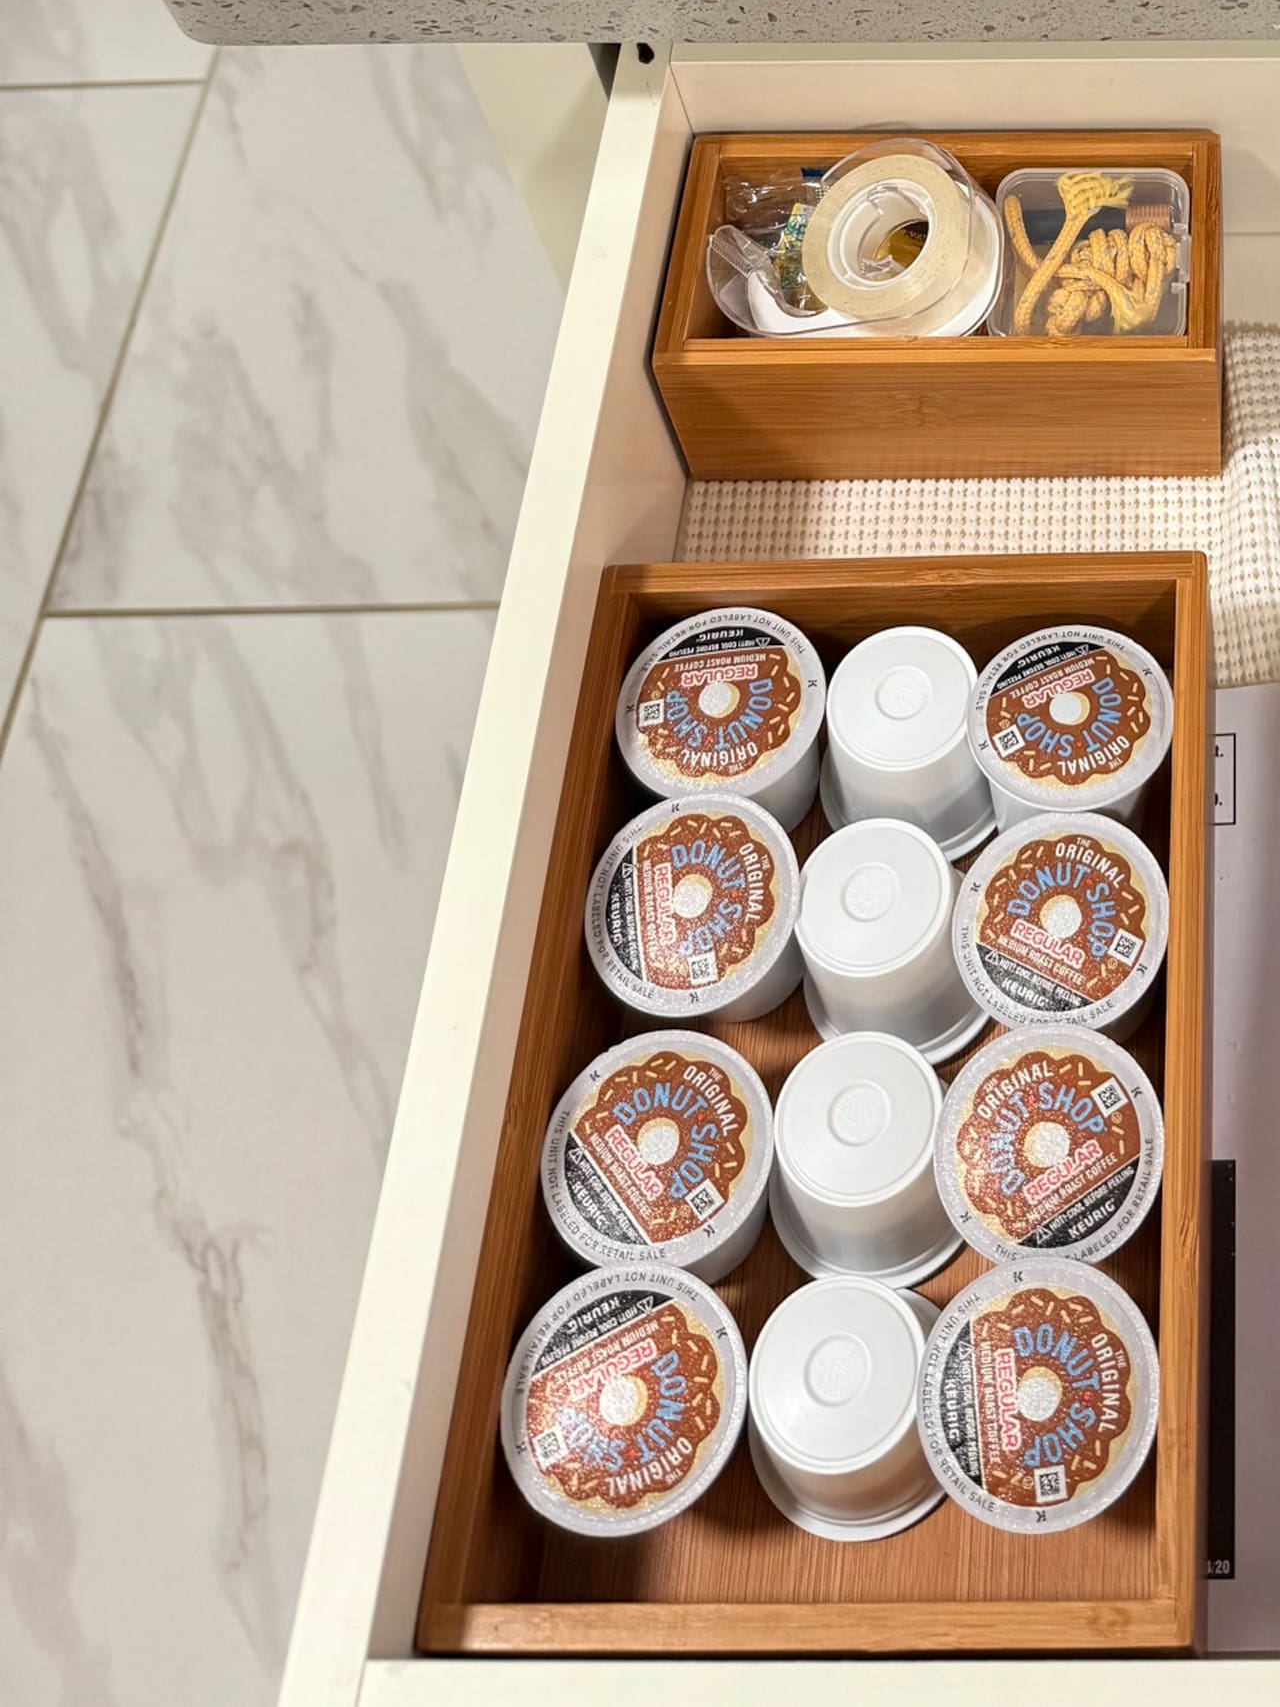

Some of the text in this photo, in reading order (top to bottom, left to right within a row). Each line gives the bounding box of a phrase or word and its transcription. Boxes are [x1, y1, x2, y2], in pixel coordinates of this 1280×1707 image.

[754, 615, 771, 626] NOT
[1062, 631, 1080, 639] NOT
[681, 664, 758, 687] REGULAR
[704, 653, 766, 668] MEDIUM ROAST
[1010, 659, 1095, 699] MEDIUM ROAST COFFEE
[1017, 645, 1061, 666] KEURIG
[666, 678, 773, 750] DONUT SHOP
[1022, 668, 1095, 709] REGULAR
[1016, 677, 1122, 758] DONUT SHOP
[681, 741, 758, 767] ORIGINAL
[1057, 734, 1130, 776] ORIGINAL
[1055, 843, 1125, 889] ORIGINAL
[1076, 837, 1091, 848] THE
[654, 862, 676, 944] REGULAR
[671, 840, 746, 957] DONUT SHOP
[739, 843, 764, 924] ORIGINAL
[1007, 861, 1116, 957] DONUT SHOP
[1010, 919, 1086, 969] REGULAR
[1053, 961, 1086, 985] COFFEE
[683, 1065, 739, 1137] ORIGINAL
[707, 1067, 723, 1081] THE
[976, 1061, 1054, 1119] ORIGINAL
[1037, 1081, 1105, 1134] SHOP
[605, 1124, 664, 1199] REGULAR
[612, 1082, 718, 1198] DONUT SHOP
[1086, 1152, 1118, 1181] COFFEE
[1023, 1140, 1104, 1204] REGULAR
[1068, 1199, 1116, 1239] KEURIG
[569, 1338, 658, 1397] REGULAR
[1013, 1323, 1100, 1391] DONUT
[1091, 1332, 1121, 1433] ORIGINAL
[1115, 1348, 1125, 1368] THE
[635, 1350, 688, 1464] DONUT
[996, 1348, 1023, 1451] REGULAR
[1023, 1401, 1097, 1467] SHOP
[607, 1436, 693, 1496] ORIGINAL
